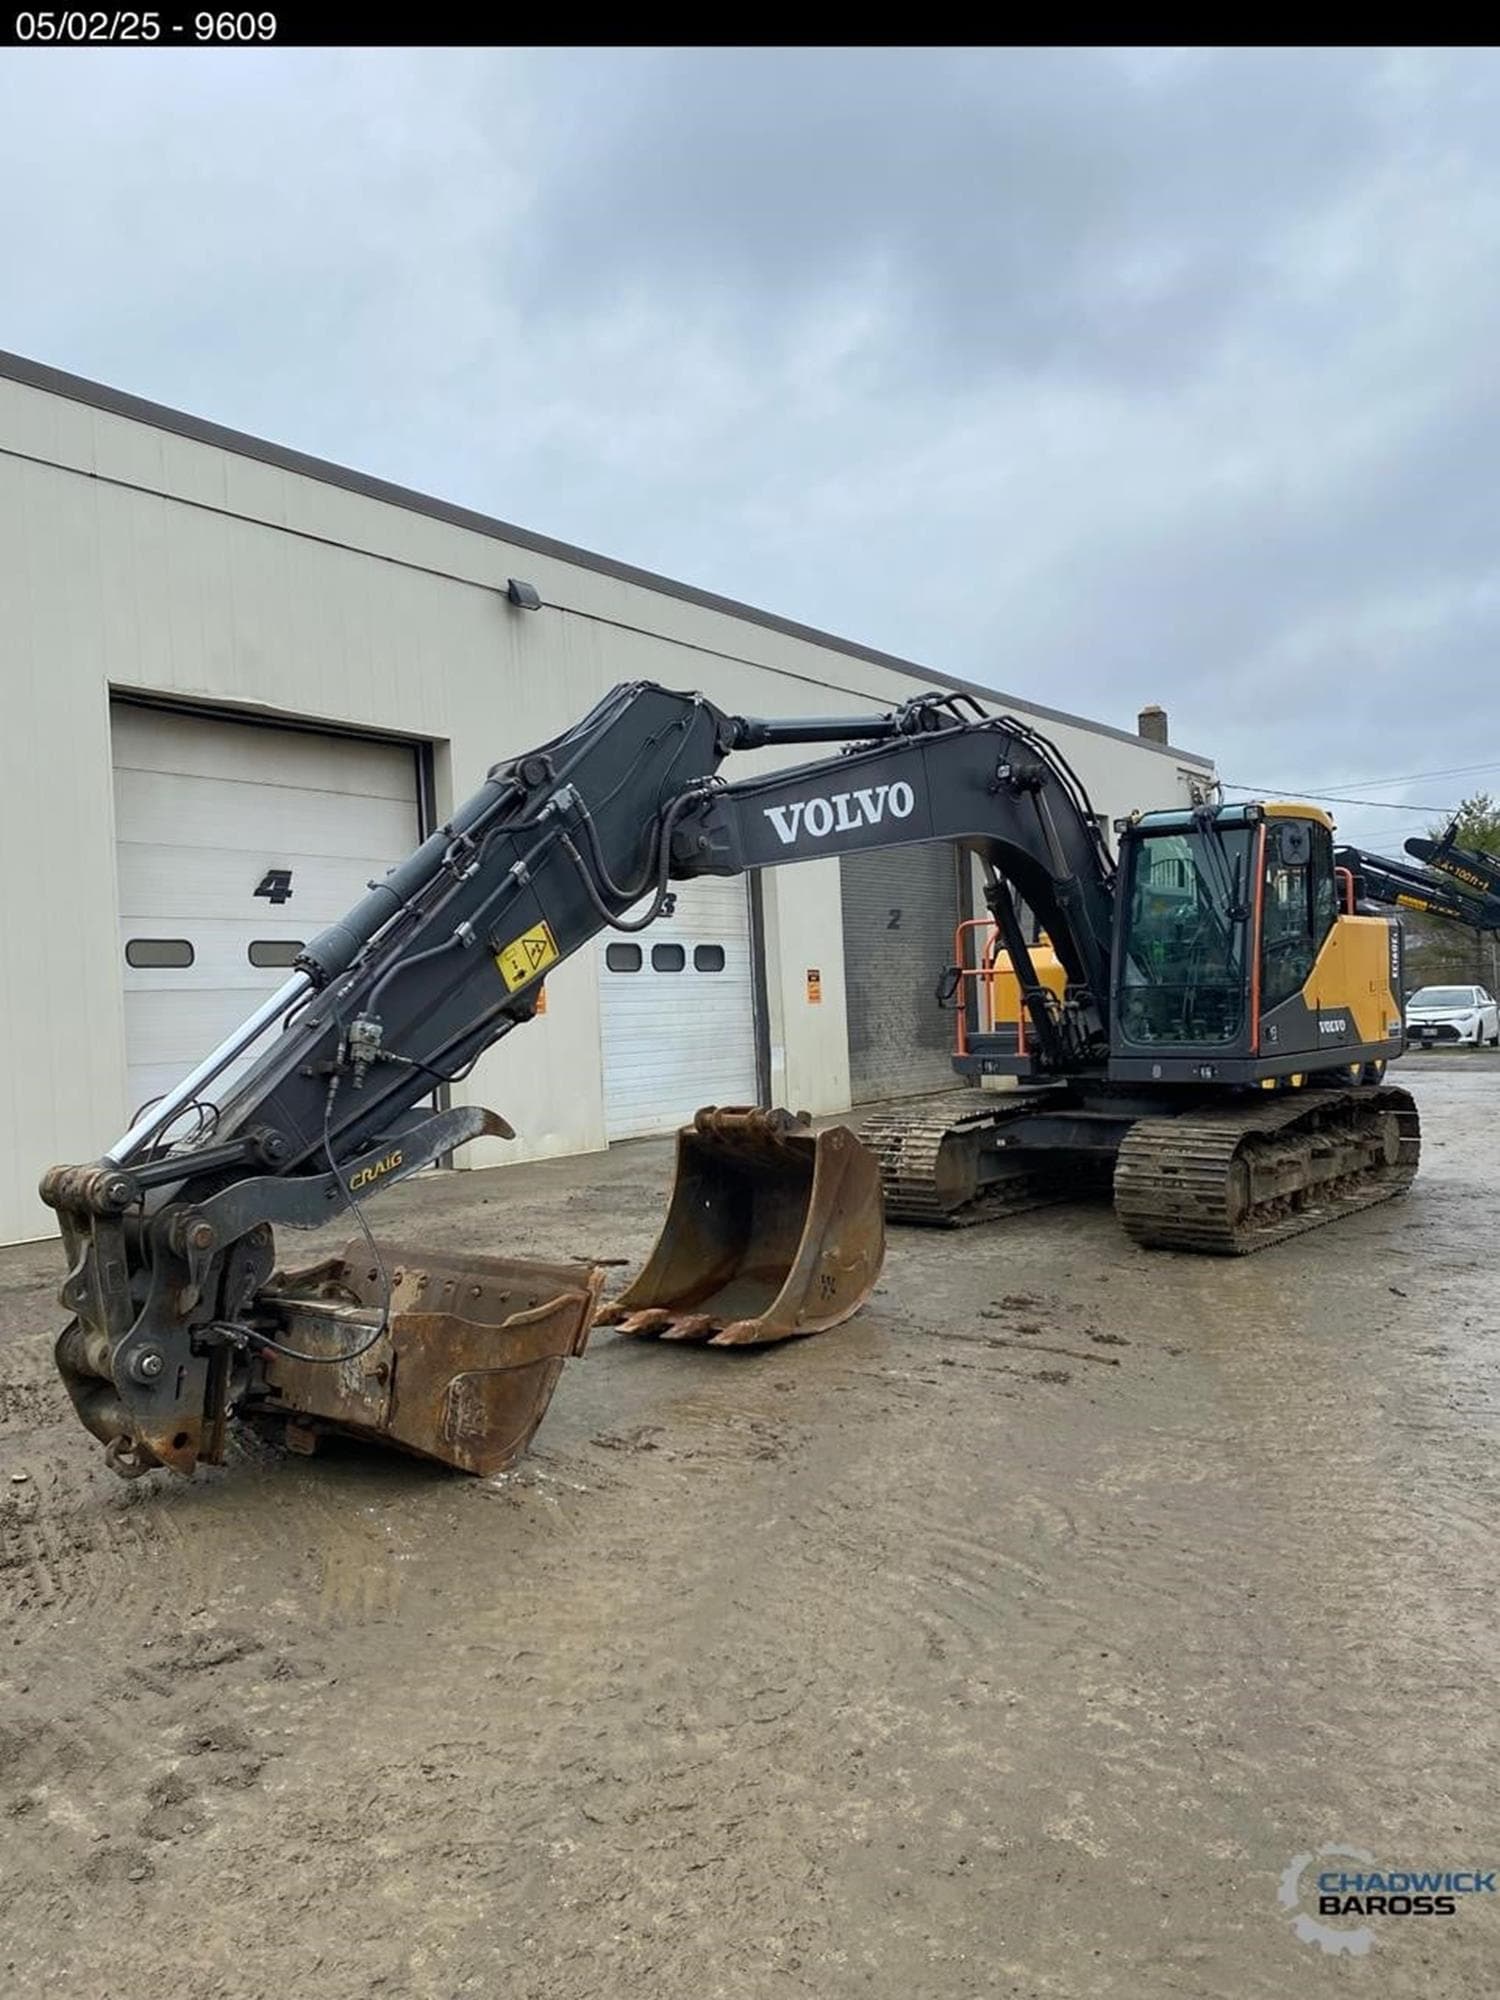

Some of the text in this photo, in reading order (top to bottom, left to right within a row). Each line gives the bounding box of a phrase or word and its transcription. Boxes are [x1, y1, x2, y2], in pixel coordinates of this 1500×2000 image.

[763, 781, 915, 844] VOLVO
[253, 869, 293, 904] 4
[887, 909, 901, 930] 2
[1318, 1019, 1347, 1034] VOLVO
[350, 1149, 402, 1190] CRAIG
